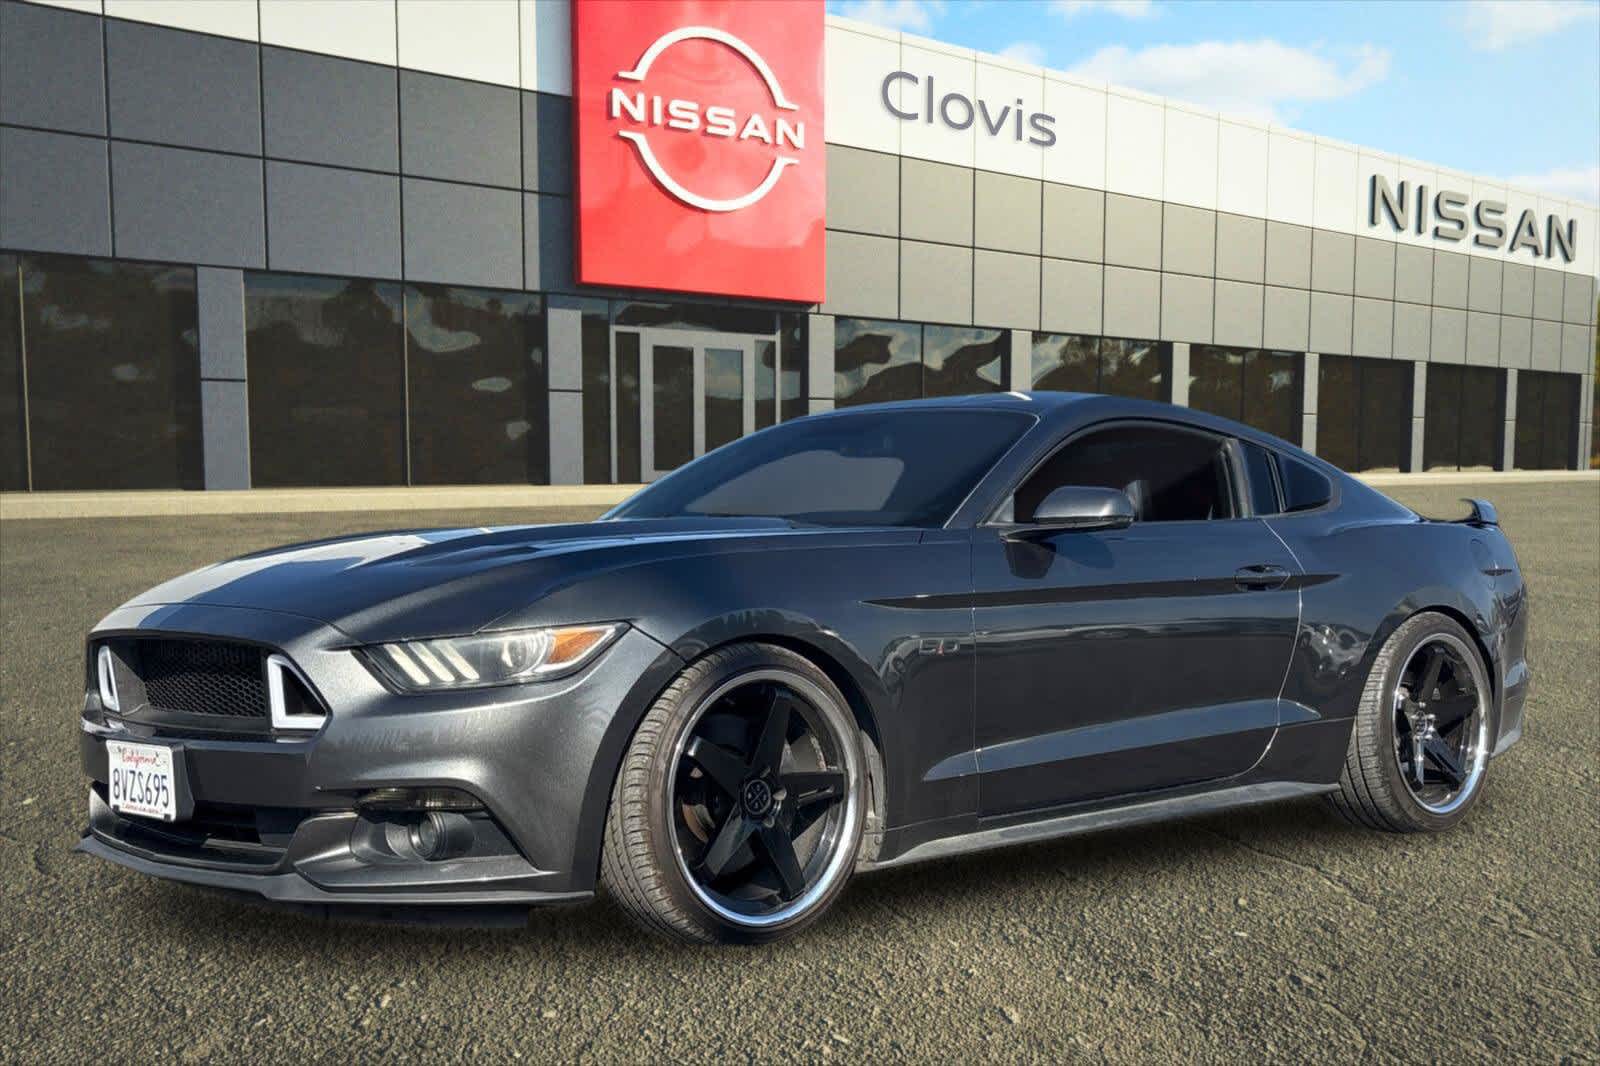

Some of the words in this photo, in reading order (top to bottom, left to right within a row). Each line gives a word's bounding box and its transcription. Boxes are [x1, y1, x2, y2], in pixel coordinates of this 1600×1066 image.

[611, 87, 805, 149] NISSAN
[881, 70, 1057, 147] Clovis
[1369, 174, 1577, 263] NISSAN
[113, 768, 169, 808] 8VZS695
